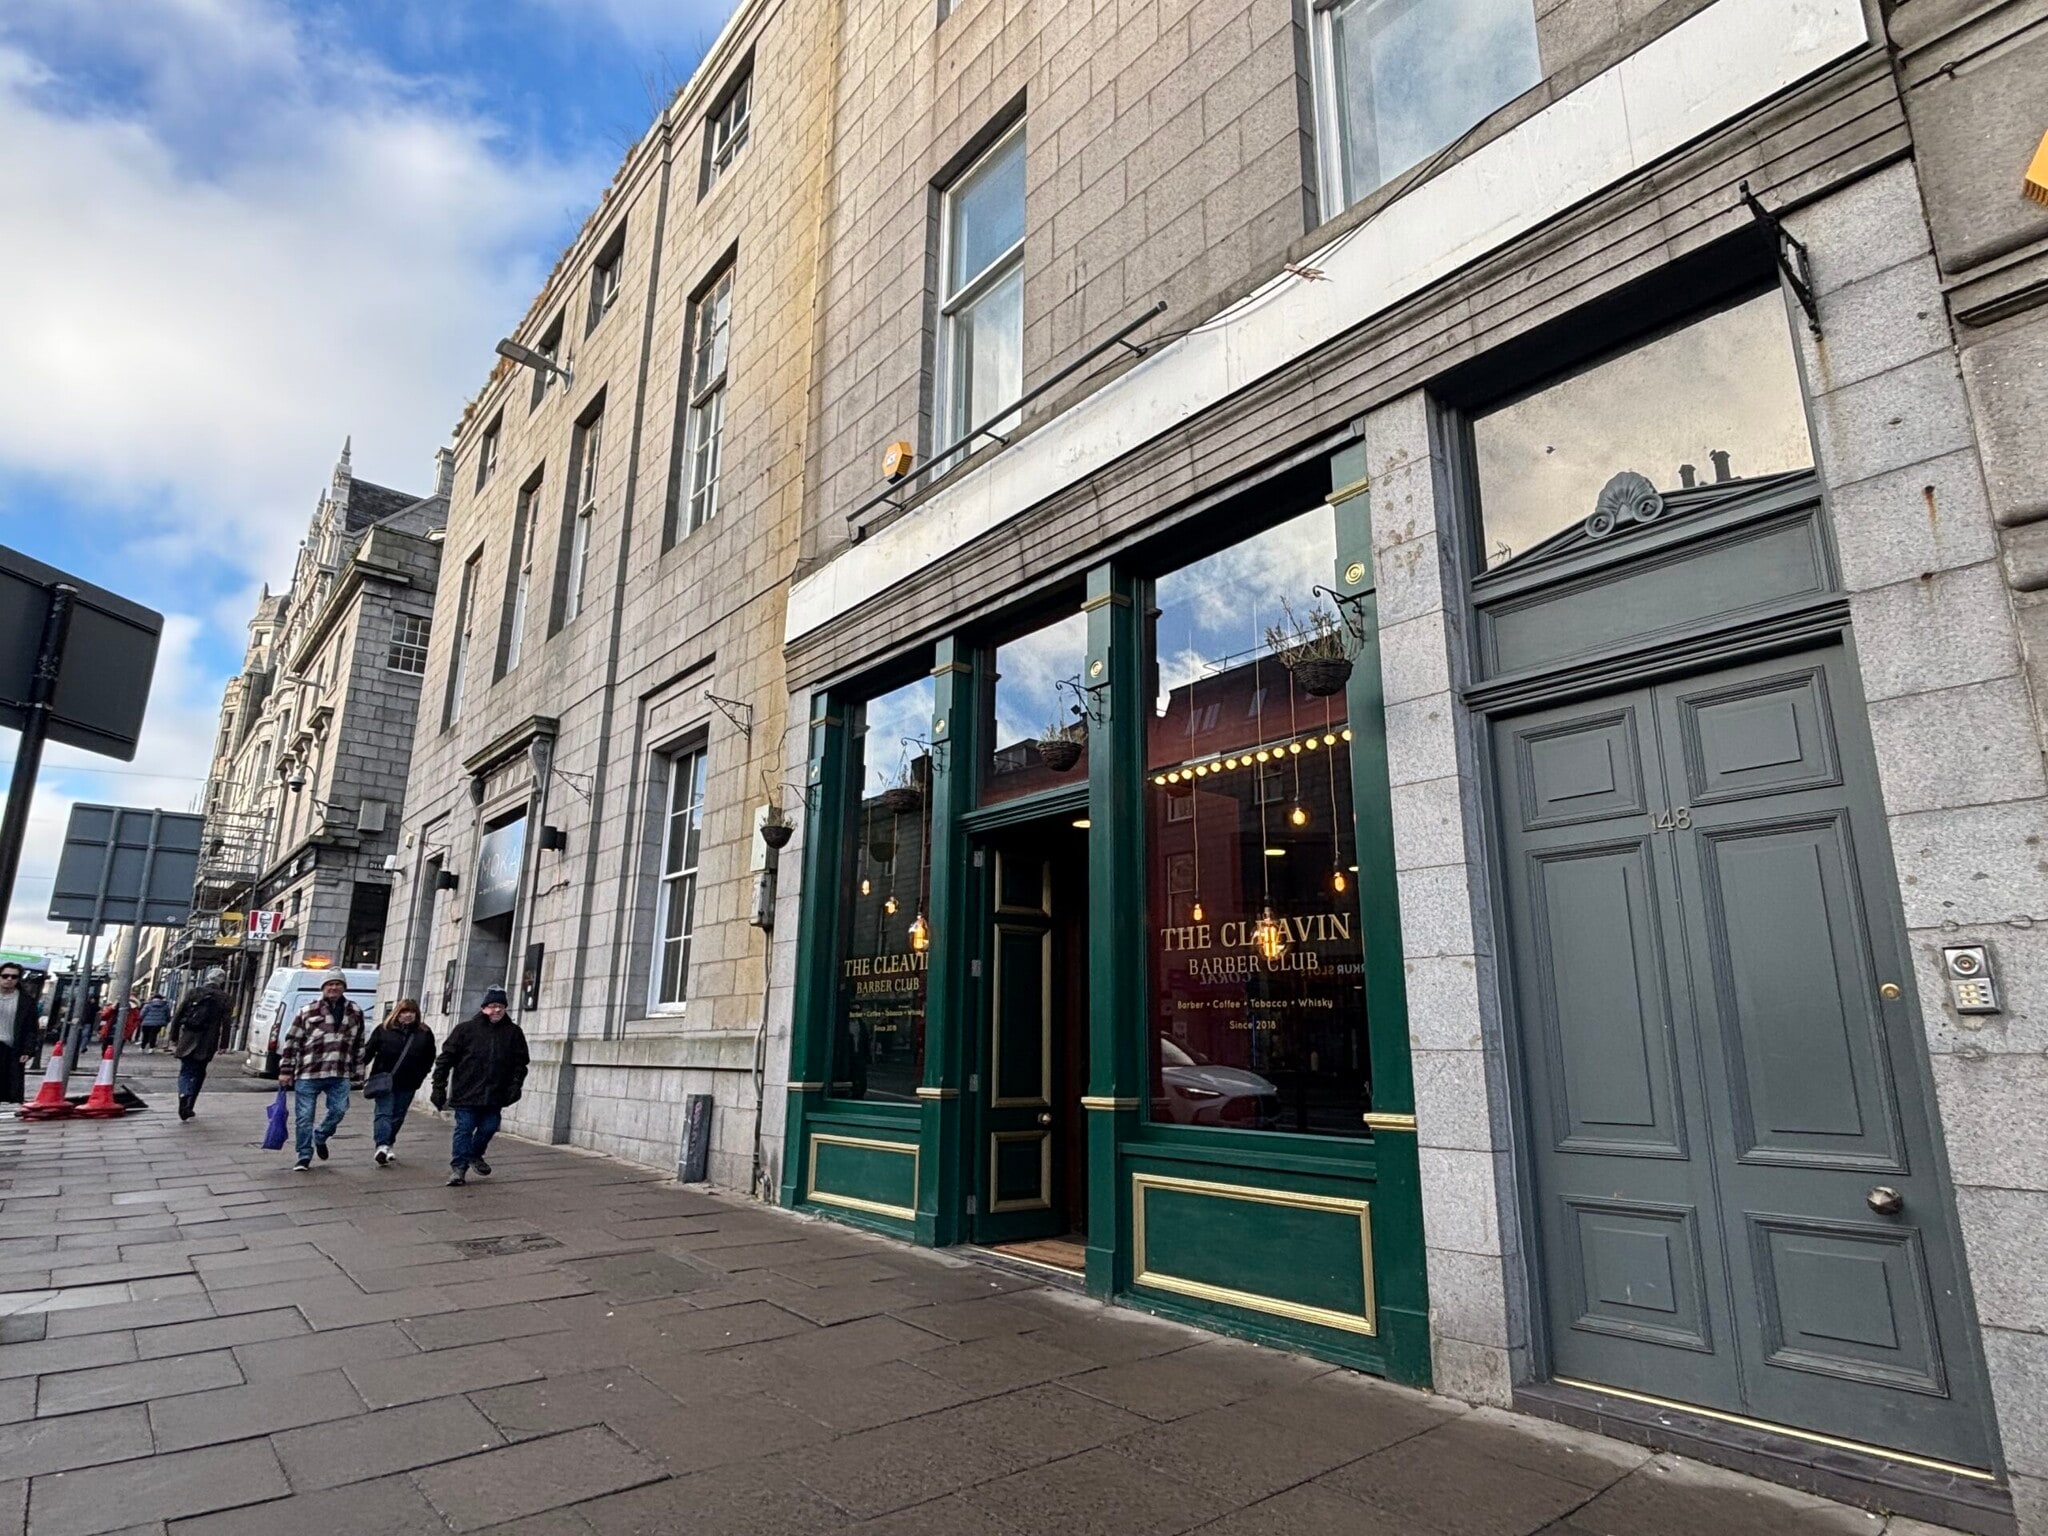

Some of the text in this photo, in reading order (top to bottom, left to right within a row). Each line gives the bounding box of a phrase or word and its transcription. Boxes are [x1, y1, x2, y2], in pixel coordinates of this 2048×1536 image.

[1648, 806, 1691, 834] 148
[1160, 924, 1212, 951] THE
[844, 958, 870, 977] THE
[1188, 951, 1318, 975] BARBER CLUB
[857, 977, 919, 994] BARBER CLUB
[1177, 997, 1333, 1009] Barber Coffee Tobacco Whisky
[1229, 1020, 1277, 1030] Since 2018
